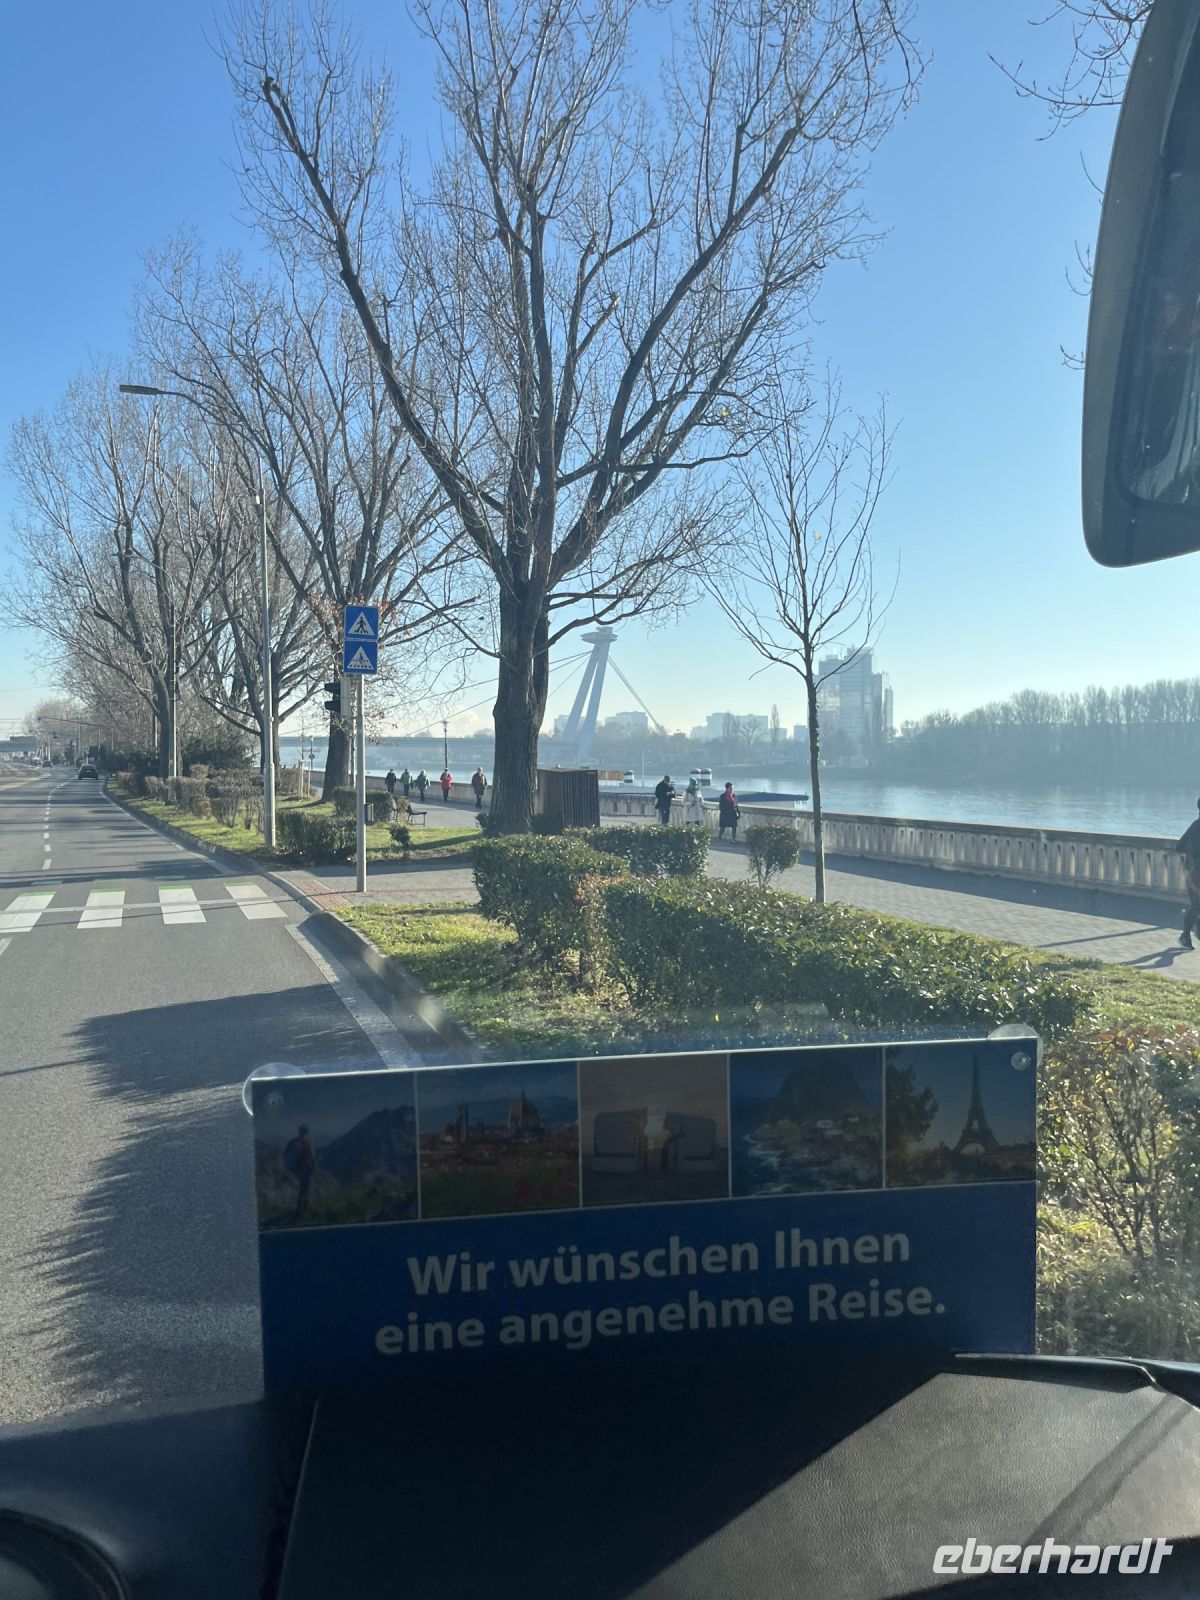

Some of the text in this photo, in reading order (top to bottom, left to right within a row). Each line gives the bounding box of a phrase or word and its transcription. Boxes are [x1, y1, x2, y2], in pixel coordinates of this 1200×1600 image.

[407, 1228, 910, 1295] Wir wünschen Ihnen
[375, 1279, 946, 1354] eine angenehme Reise.
